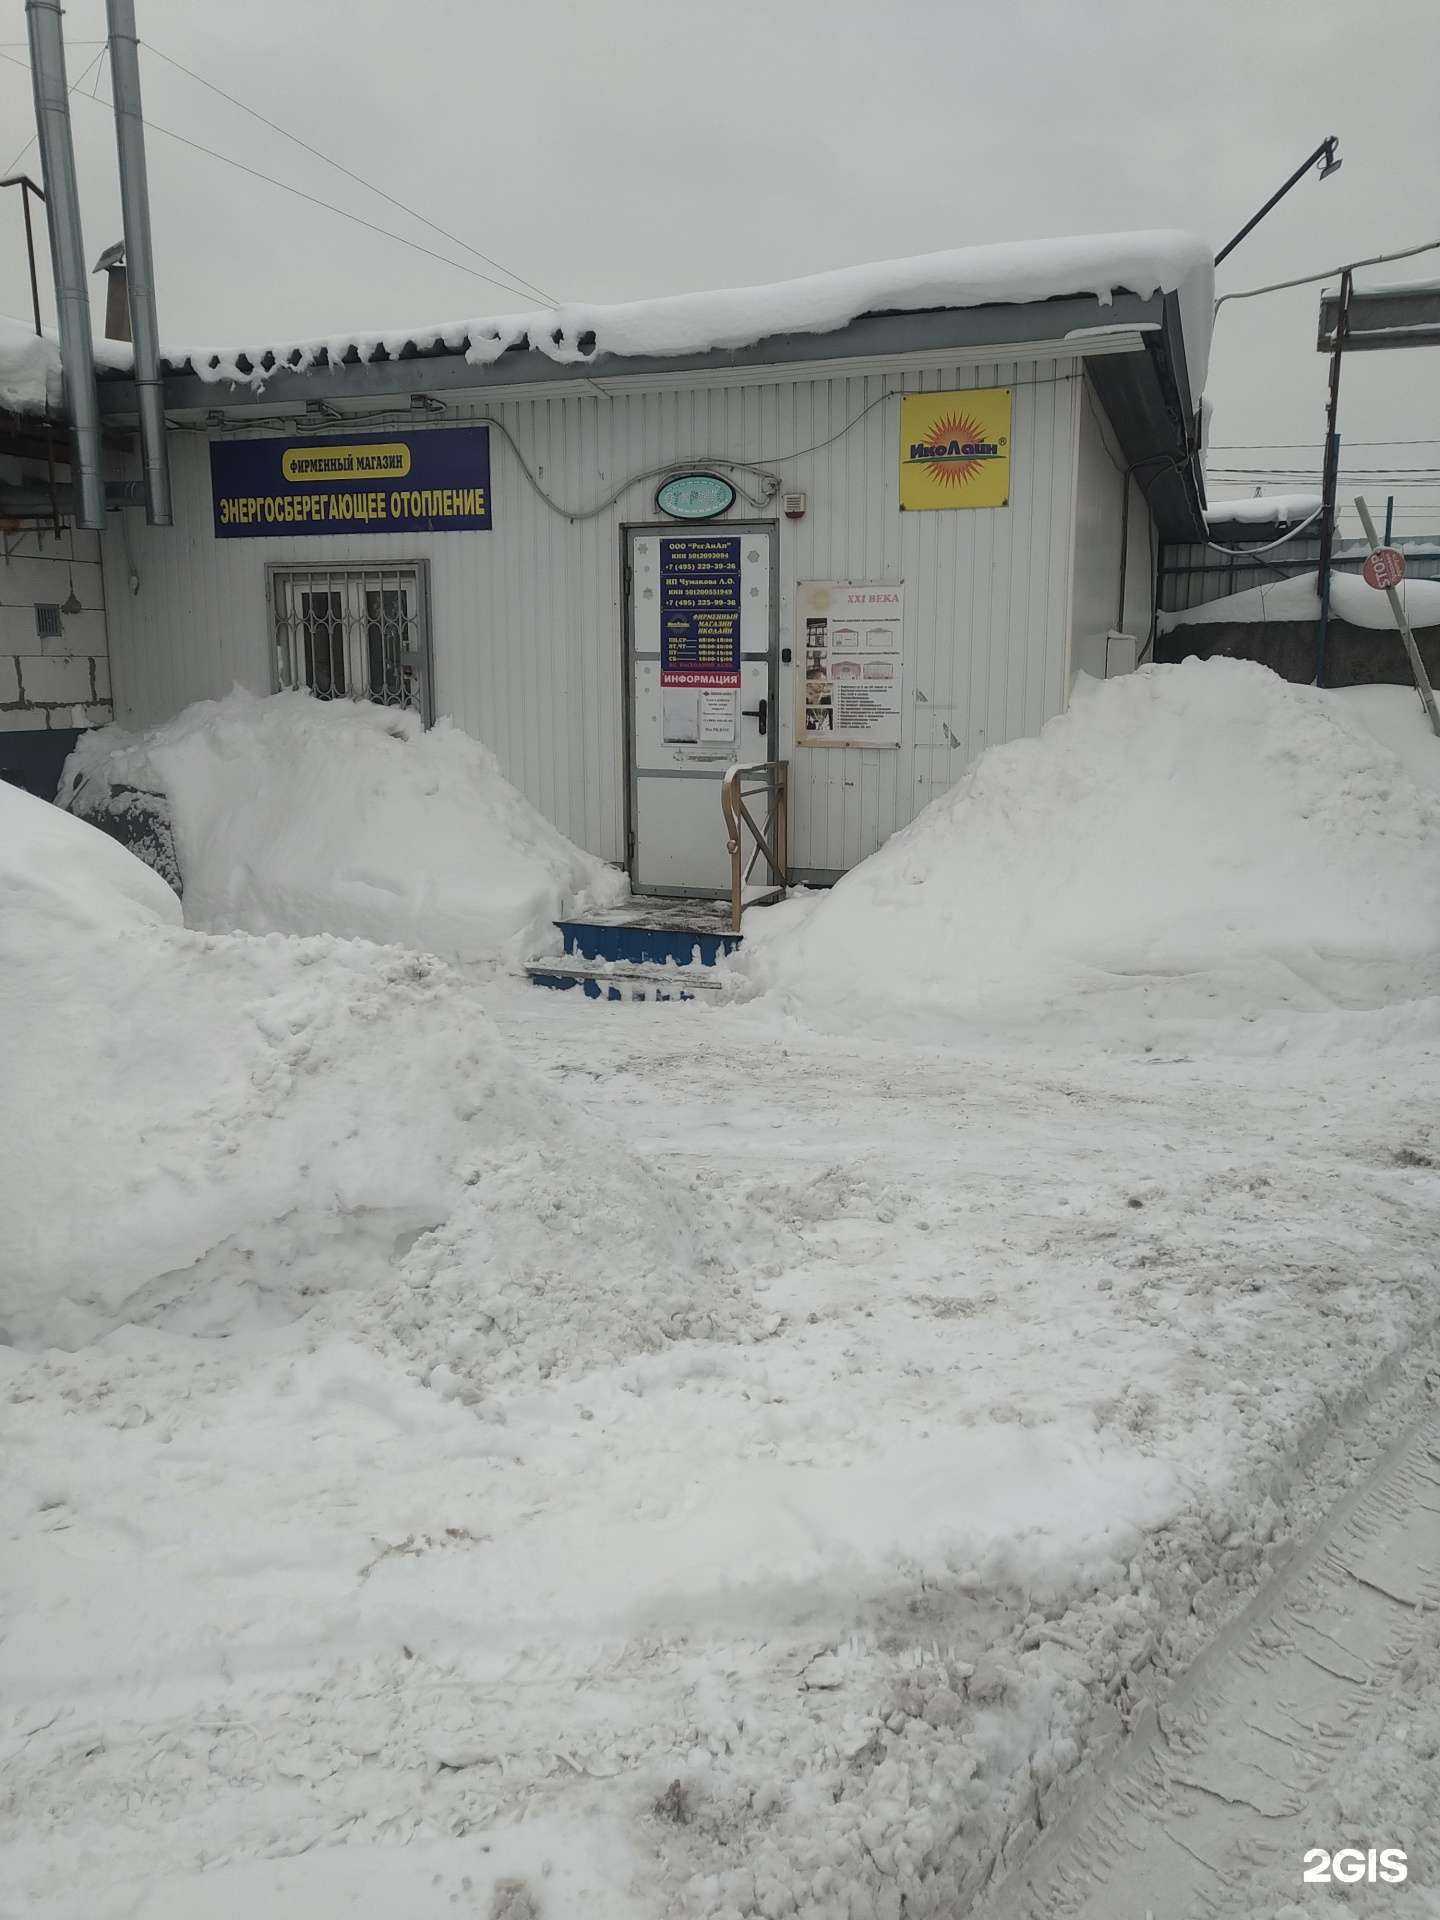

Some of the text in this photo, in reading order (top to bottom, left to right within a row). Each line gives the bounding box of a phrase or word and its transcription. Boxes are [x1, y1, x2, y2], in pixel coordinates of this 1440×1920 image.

[910, 439, 998, 458] ИкоЛайн
[289, 453, 403, 474] ФИРМЕННЫЙ МАГАЗИН
[219, 488, 485, 524] ЭНЕРГОСБЕРЕГАЮЩЕЕ ОТОПЛЕНИЕ
[674, 563, 695, 571] (495)
[847, 592, 899, 603] XXI ВЕКА
[664, 674, 737, 685] ИНФОРМАЦИЯ
